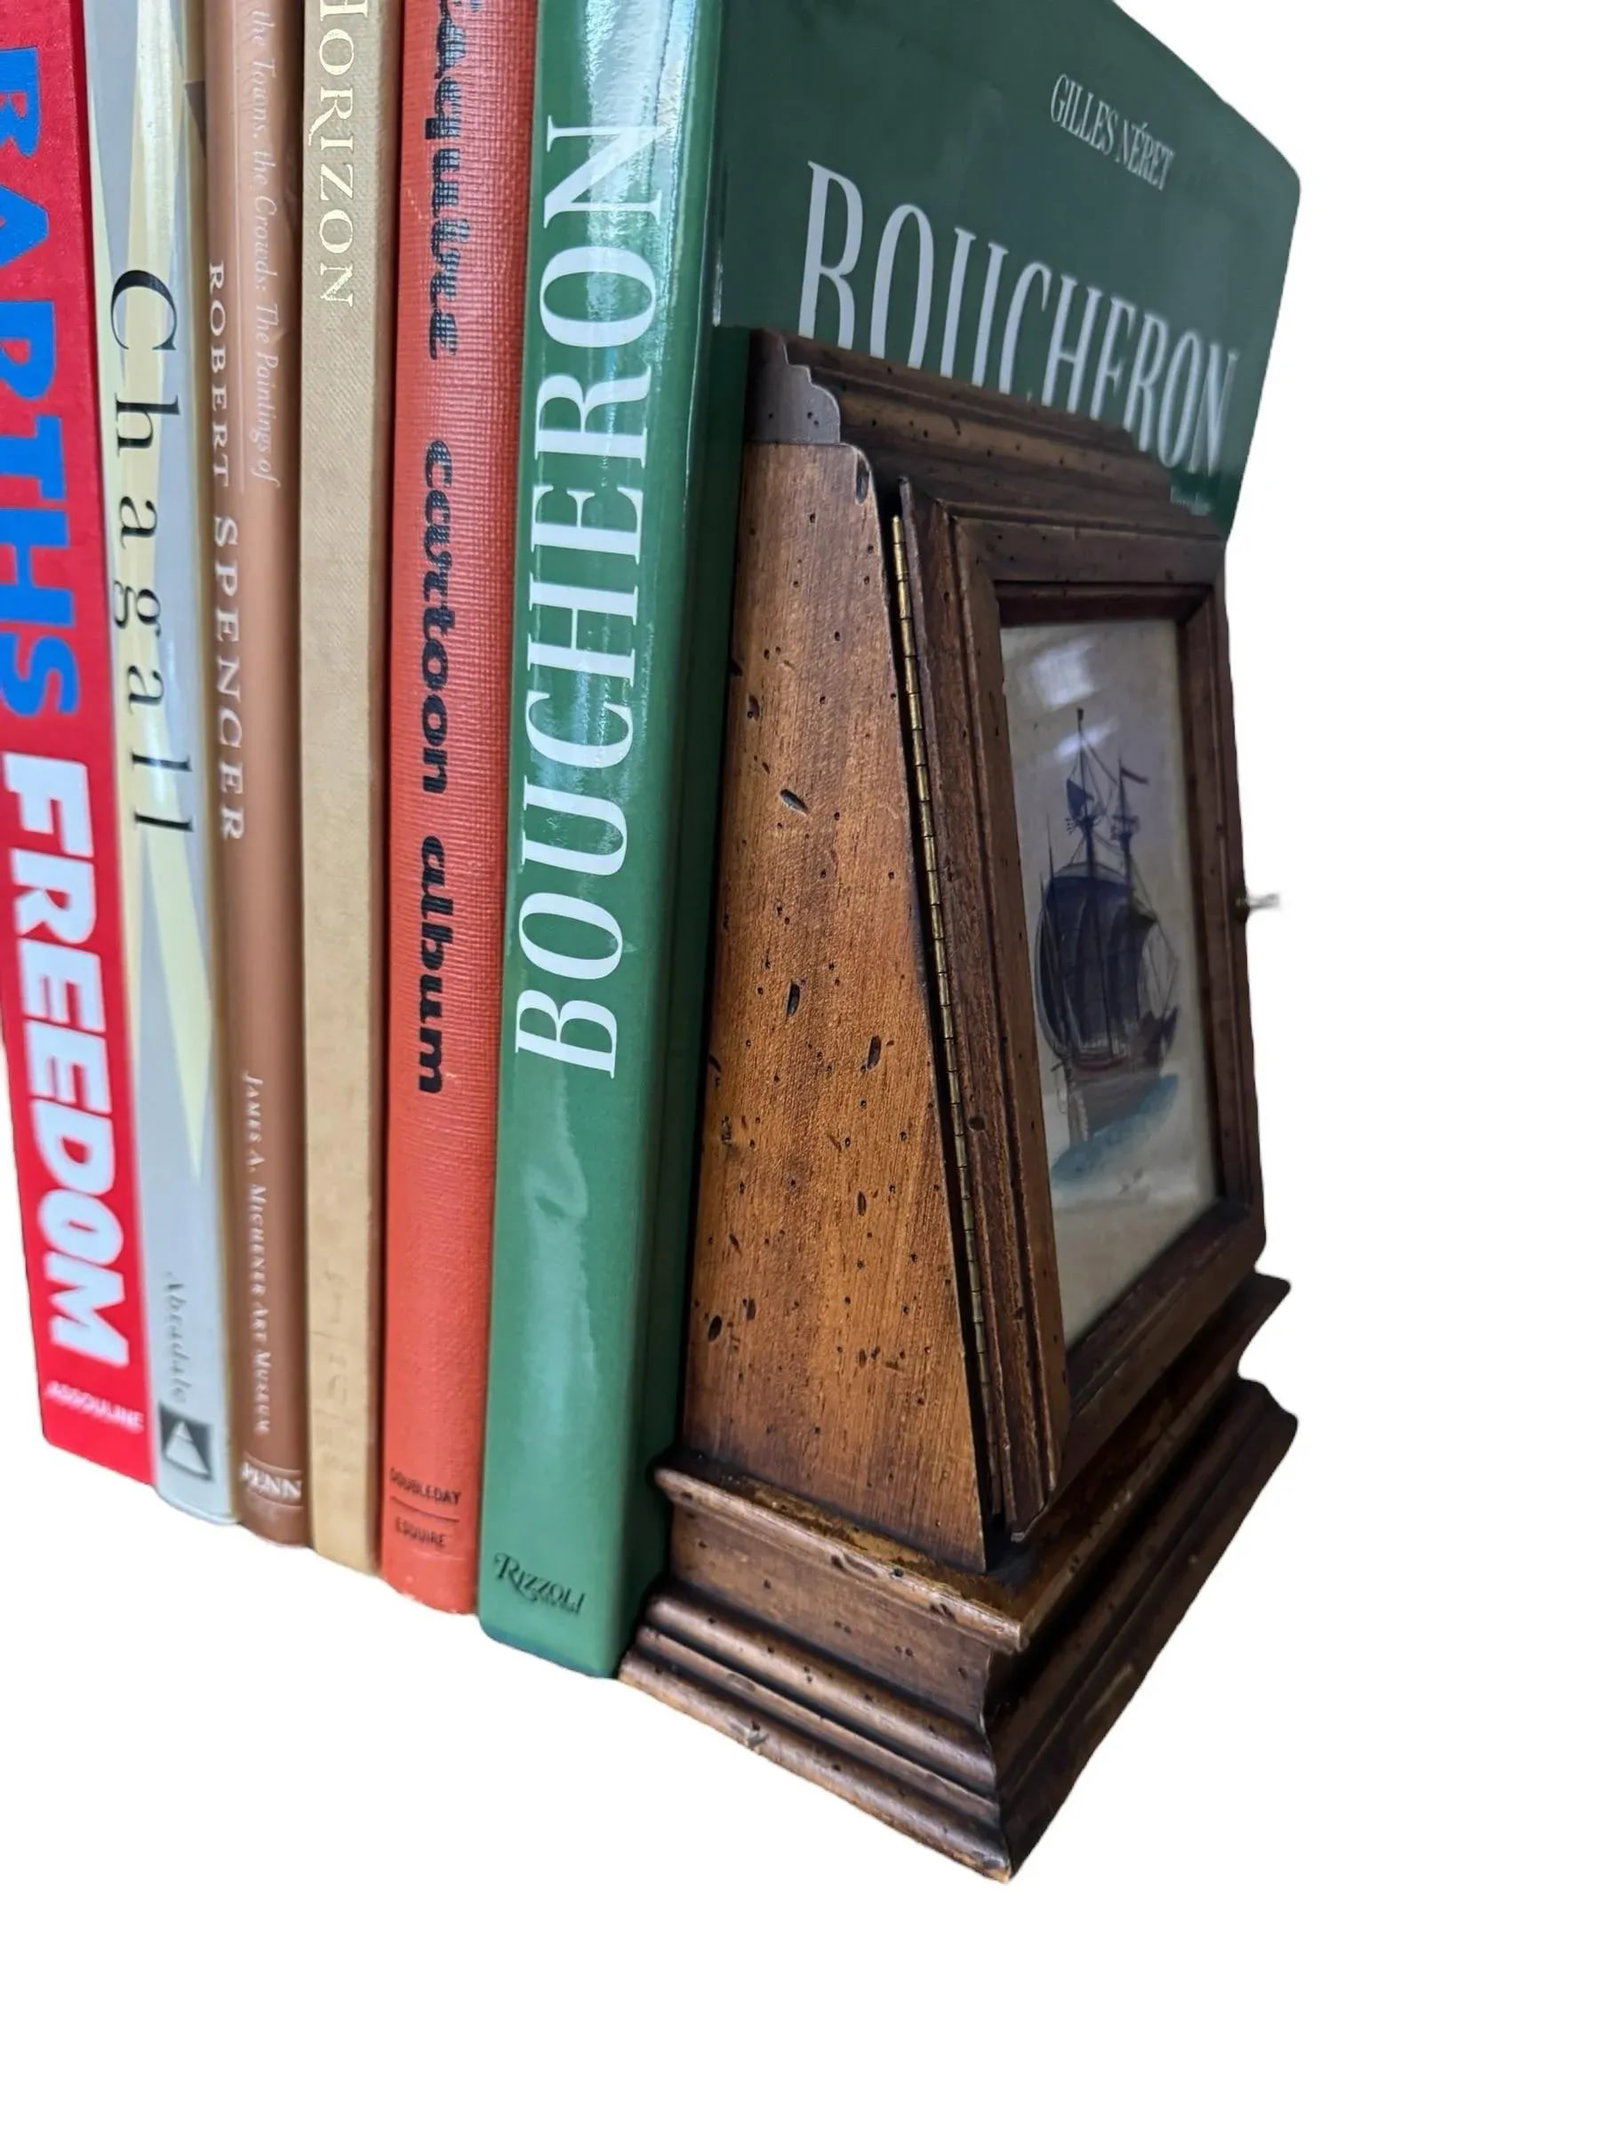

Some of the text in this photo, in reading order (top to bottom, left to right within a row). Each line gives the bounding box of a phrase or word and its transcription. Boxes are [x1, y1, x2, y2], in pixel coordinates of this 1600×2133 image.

[252, 10, 276, 46] the
[253, 150, 277, 186] the
[1050, 73, 1175, 190] GILLES NÉRET
[254, 196, 278, 292] Crowds:
[256, 303, 279, 345] The
[250, 351, 279, 451] Paintings
[251, 459, 281, 488] of
[110, 270, 194, 833] Chagall
[209, 262, 245, 840] ROBERT SPENCER
[515, 115, 672, 1078] BOUCHERON
[421, 440, 456, 793] cartoon
[418, 835, 453, 1093] album
[3, 750, 129, 1369] FREEDOM
[390, 1467, 461, 1506] DOUBLEDAY
[395, 1516, 447, 1548] ESQUIRE
[494, 1552, 585, 1615] RIZZOLI
